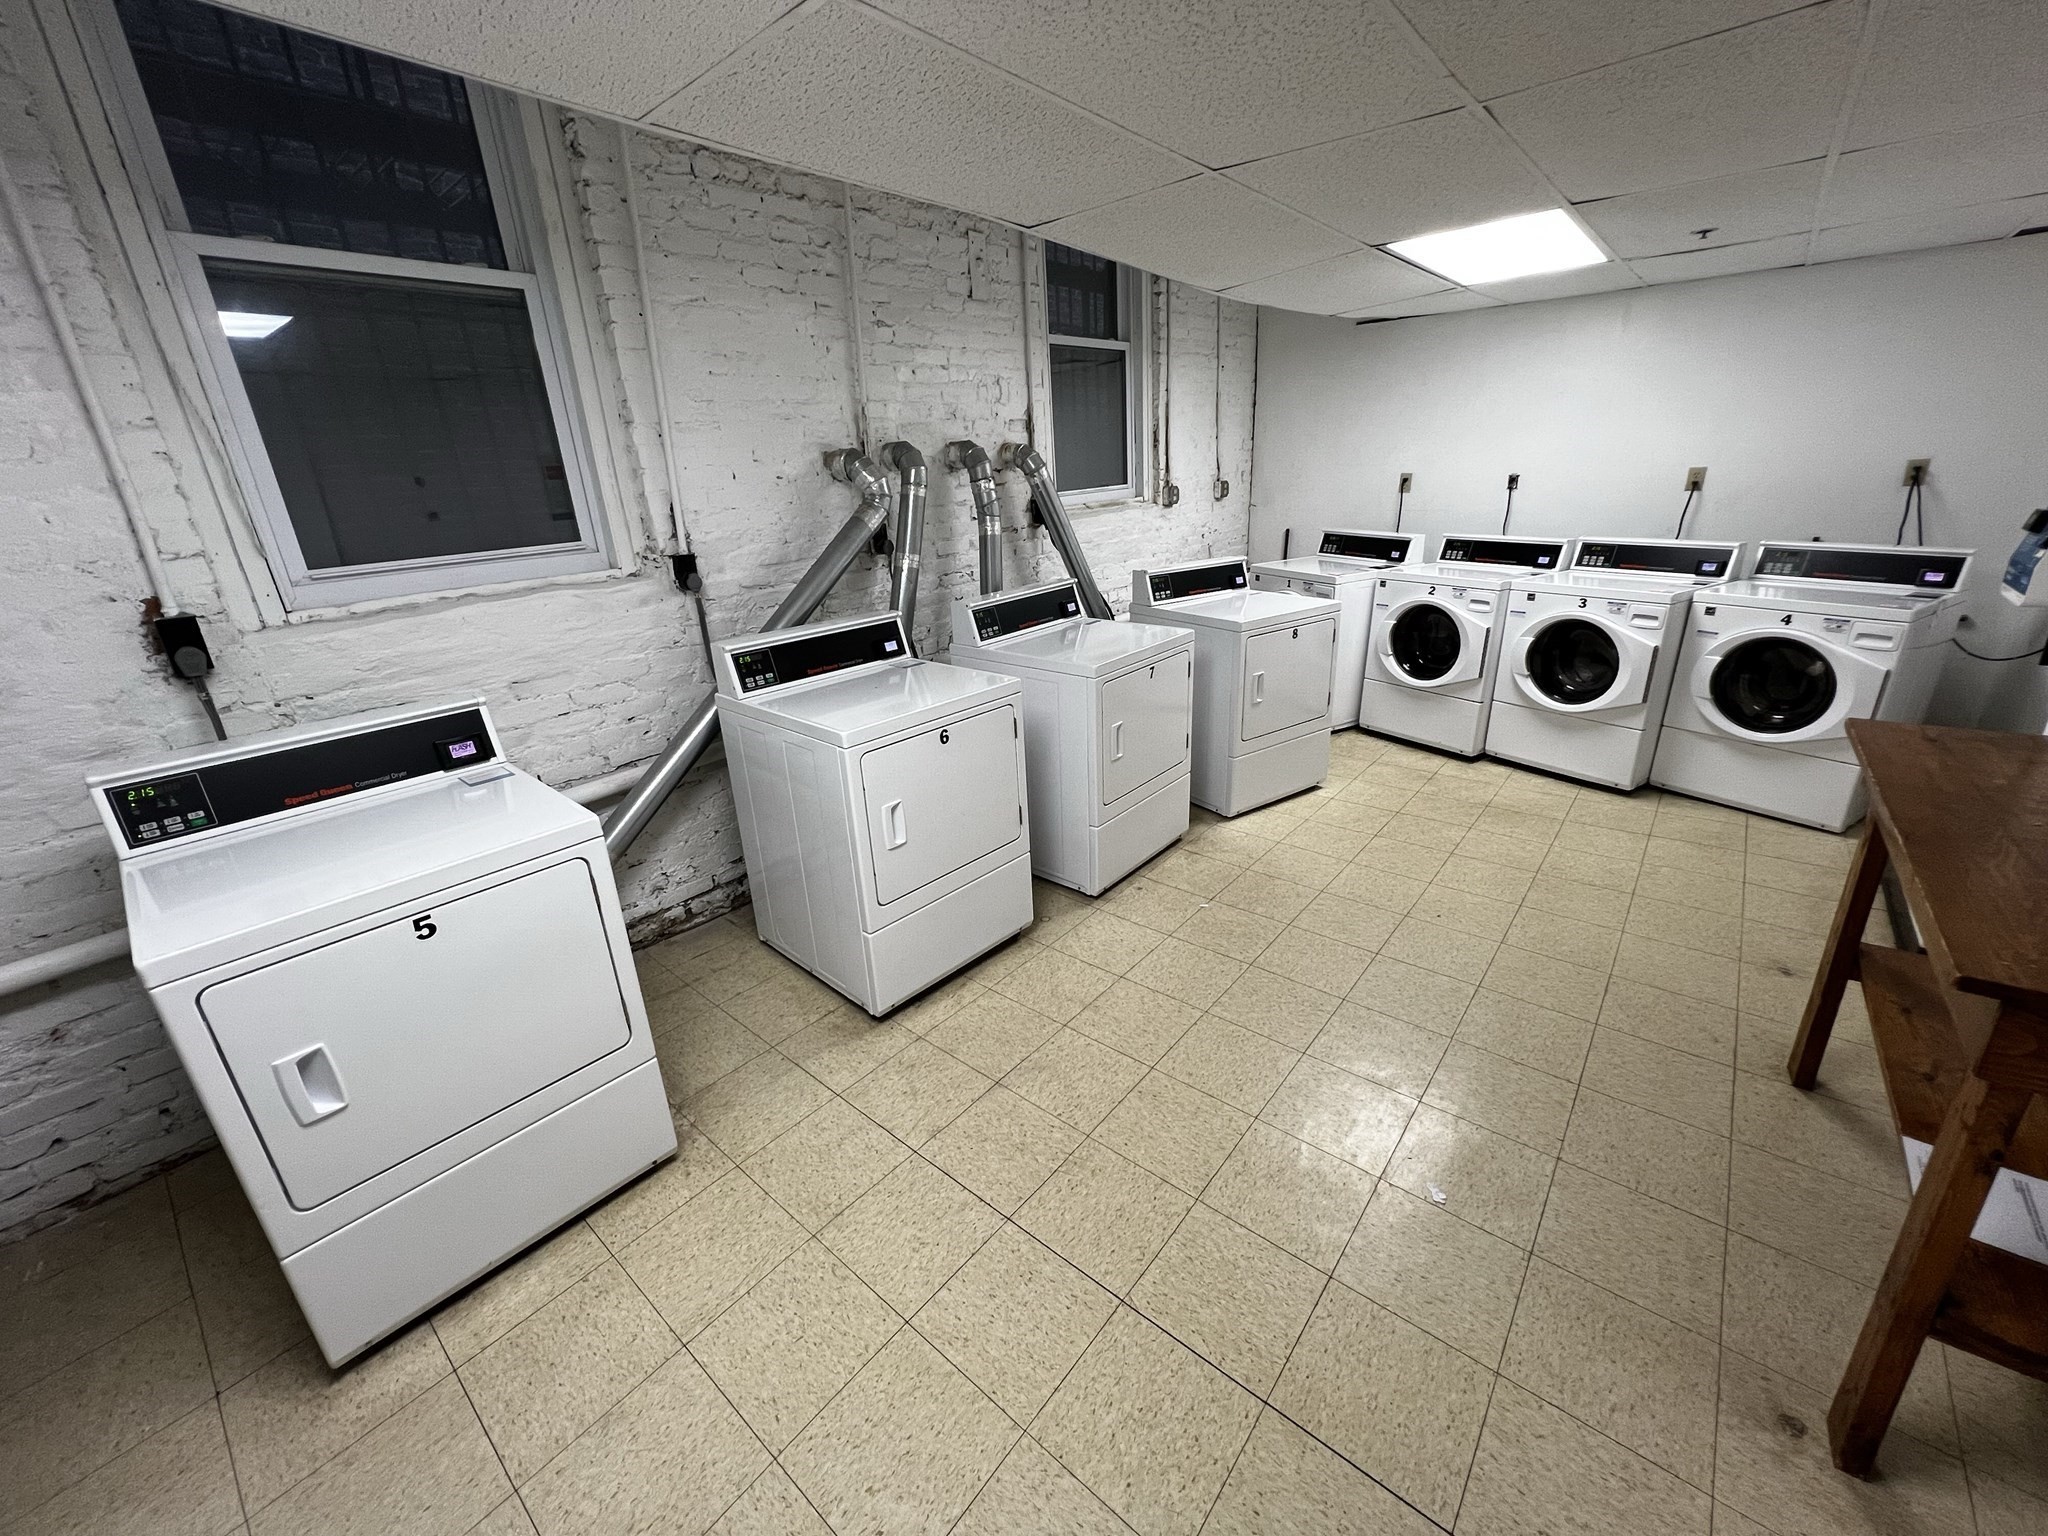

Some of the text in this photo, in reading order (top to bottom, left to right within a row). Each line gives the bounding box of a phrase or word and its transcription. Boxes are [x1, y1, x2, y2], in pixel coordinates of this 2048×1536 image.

[1428, 586, 1436, 595] 2
[1578, 598, 1588, 608] 3
[1780, 614, 1793, 626] 4
[1292, 628, 1298, 639] 8
[1150, 666, 1155, 679] 7
[940, 729, 949, 744] 6
[284, 792, 319, 806] Speed
[413, 914, 437, 940] 5
